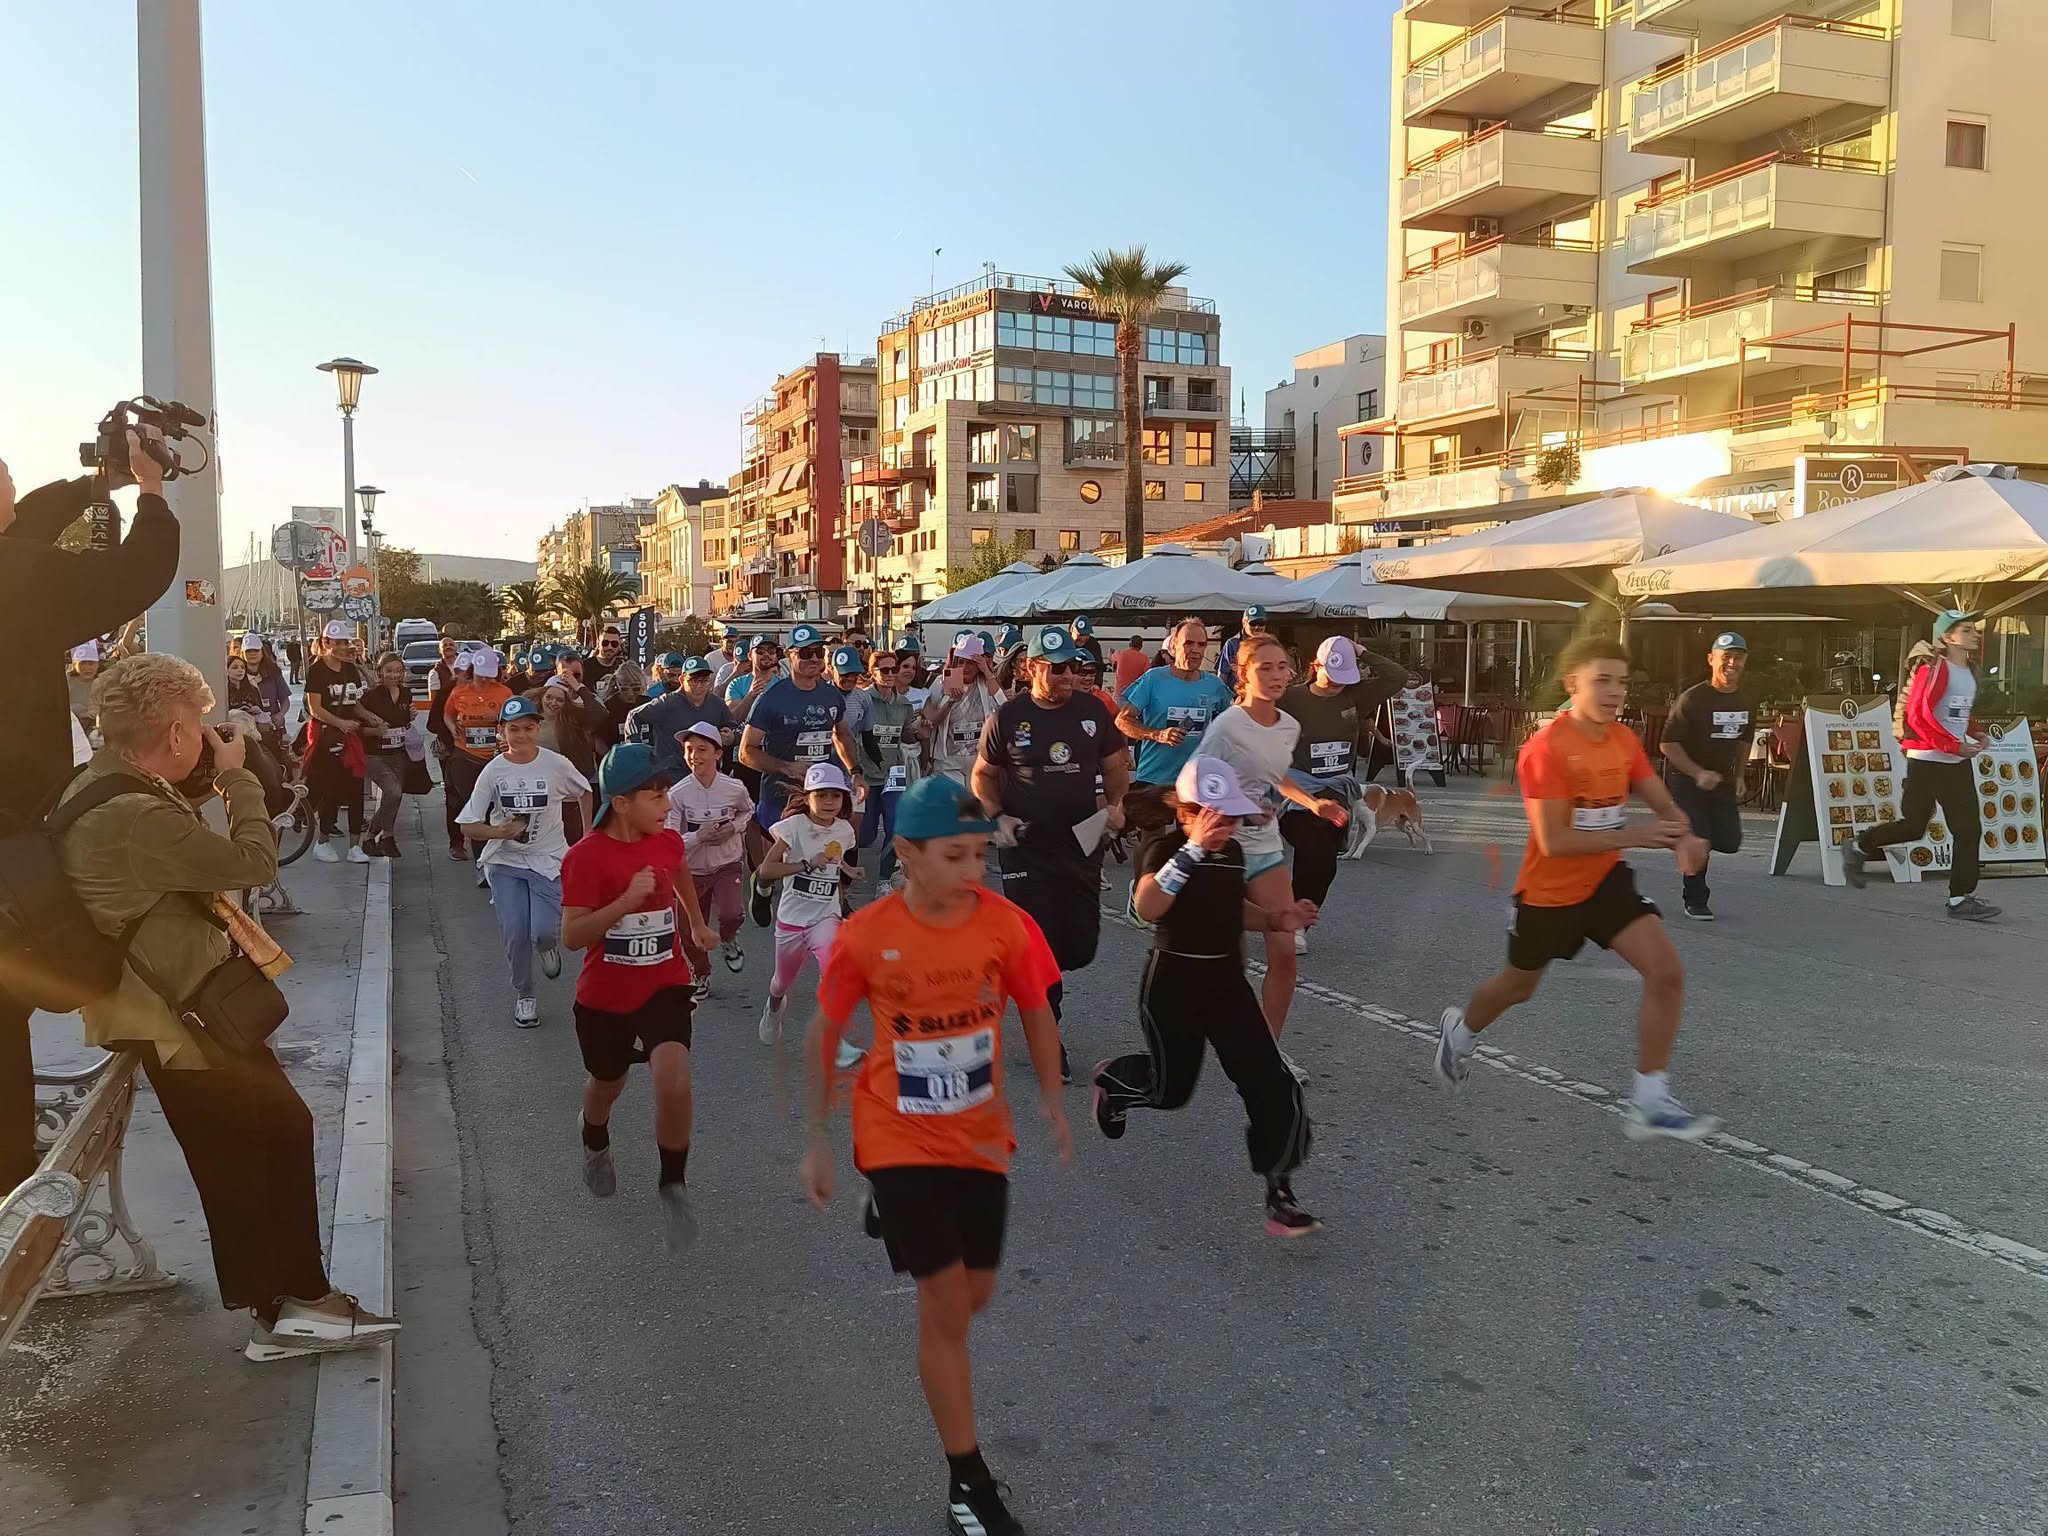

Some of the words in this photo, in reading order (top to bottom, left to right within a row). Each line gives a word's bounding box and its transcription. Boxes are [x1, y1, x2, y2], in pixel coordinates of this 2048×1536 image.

[808, 745, 824, 756] 038
[1324, 756, 1339, 767] 102
[809, 880, 832, 896] 050
[628, 937, 658, 956] 016
